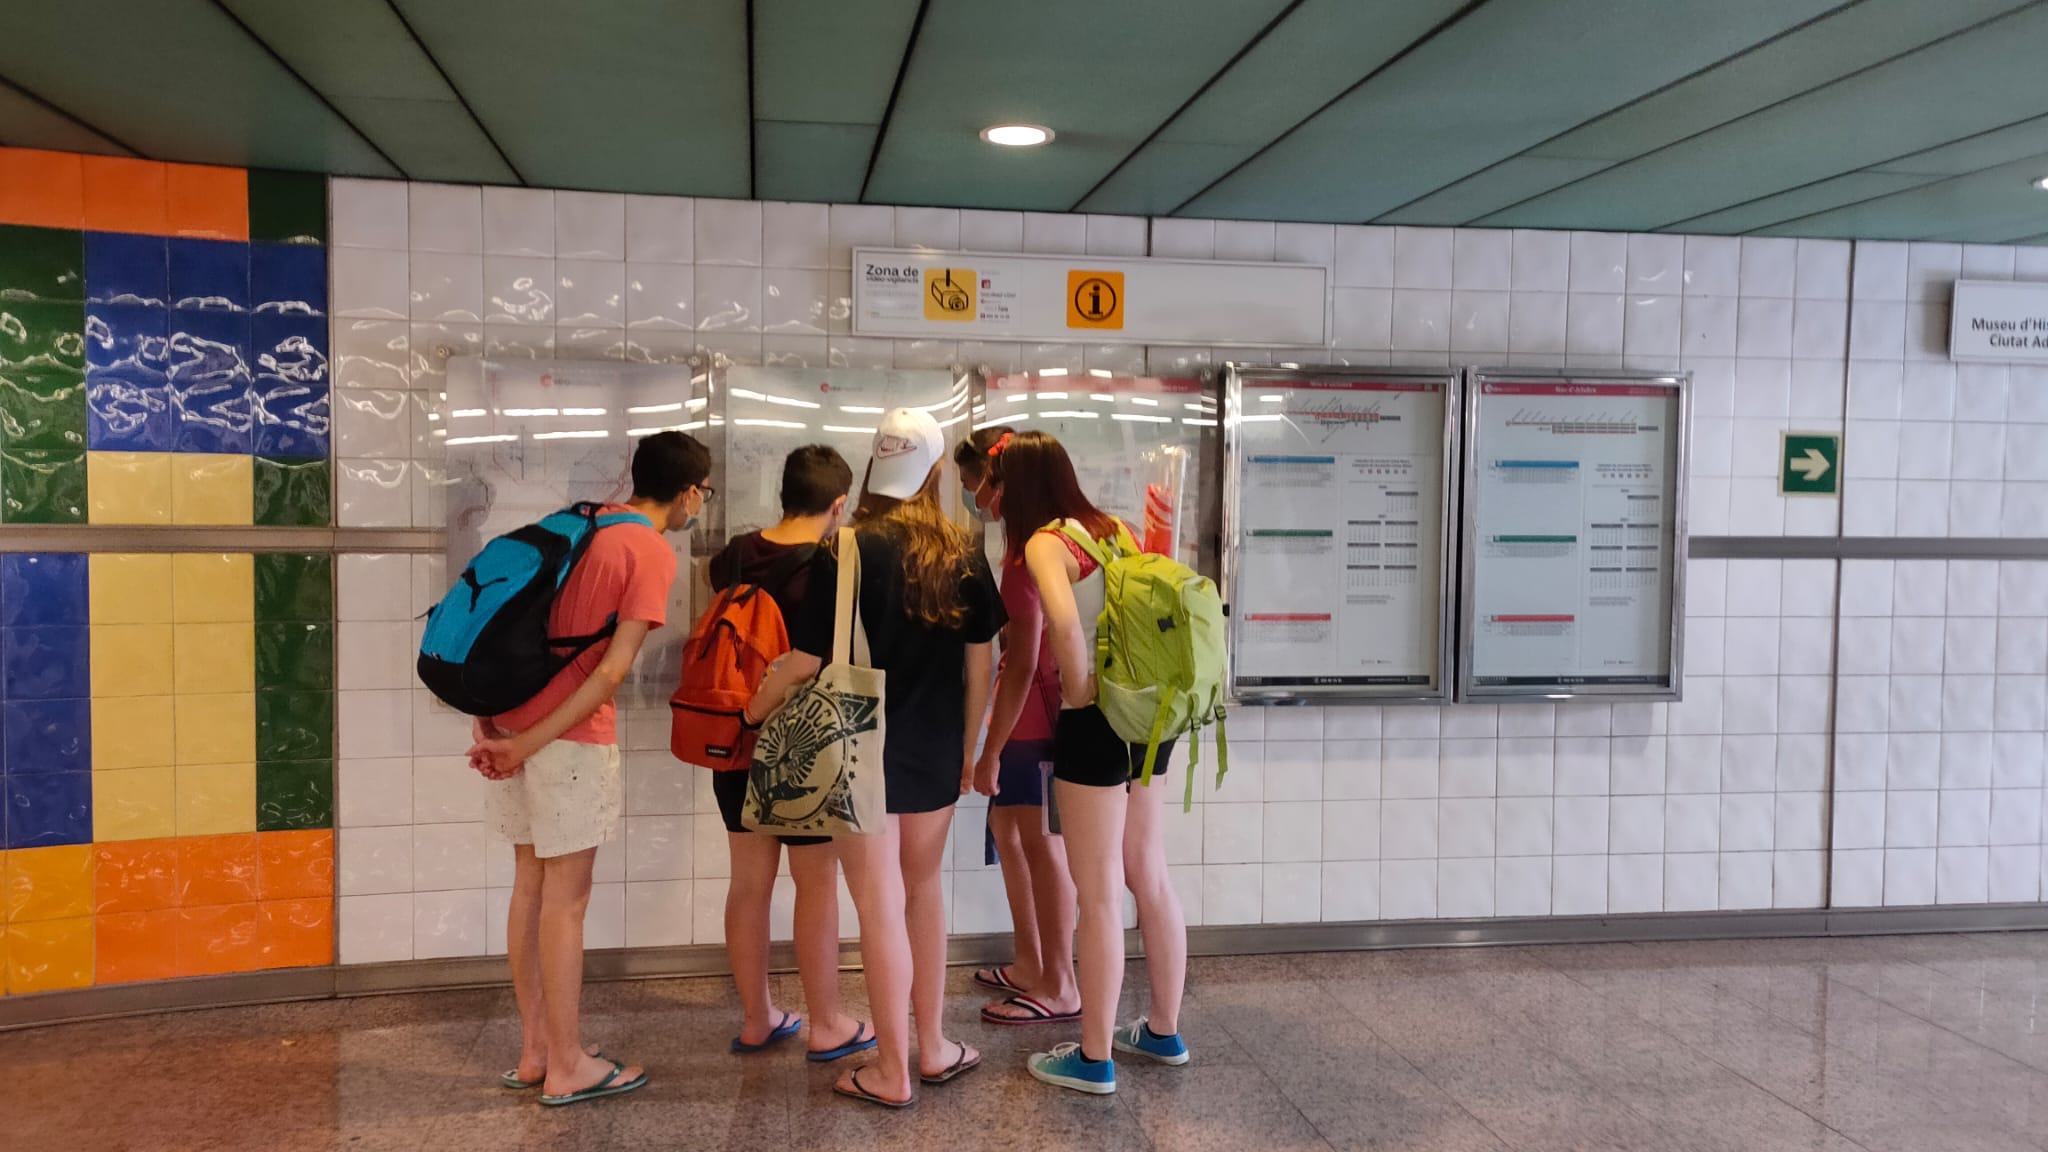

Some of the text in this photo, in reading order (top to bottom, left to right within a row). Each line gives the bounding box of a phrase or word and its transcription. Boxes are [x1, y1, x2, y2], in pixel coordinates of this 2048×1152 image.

[866, 263, 919, 277] Zona de
[1971, 317, 2016, 331] Museu
[1989, 333, 2028, 348] Ciutat
